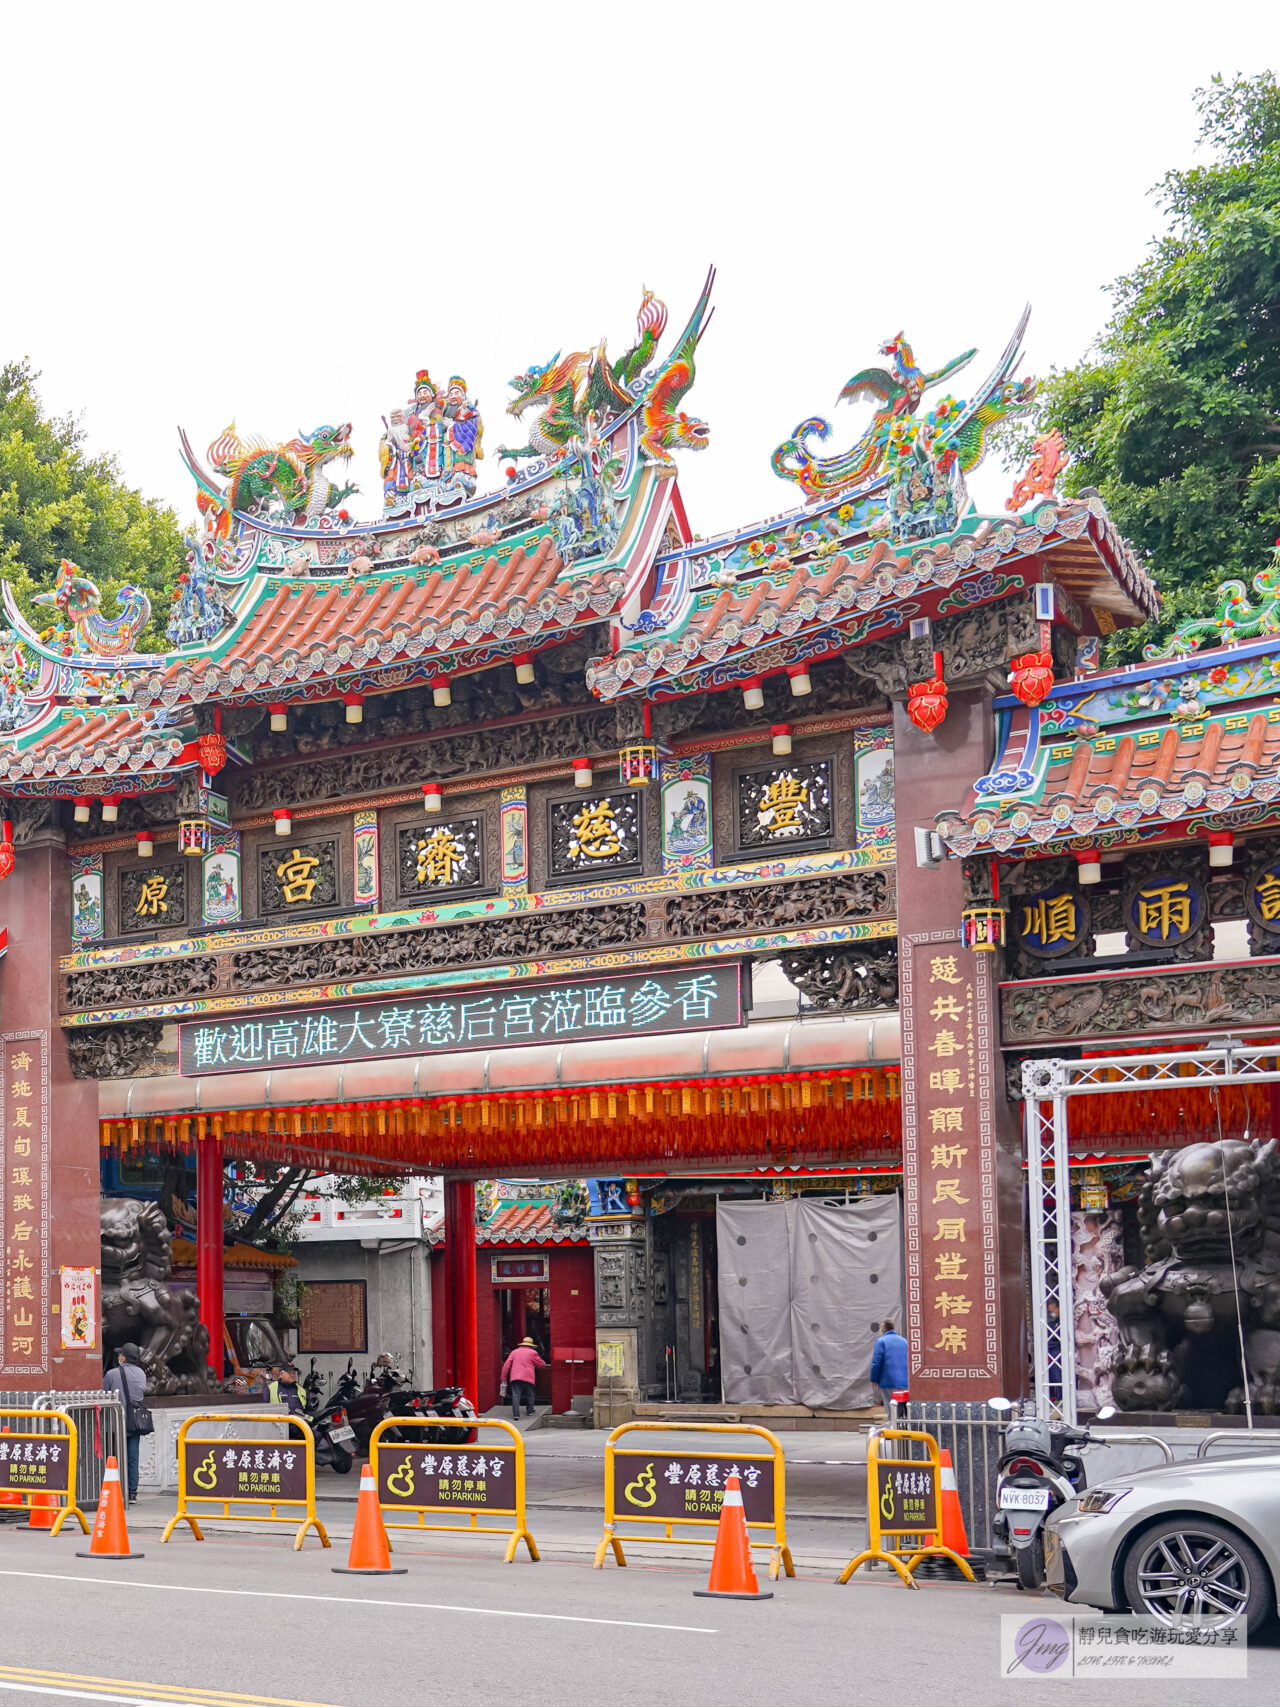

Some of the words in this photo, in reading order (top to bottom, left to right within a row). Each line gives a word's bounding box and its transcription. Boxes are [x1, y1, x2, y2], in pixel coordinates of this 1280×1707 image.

[759, 777, 808, 831] 豐
[569, 800, 620, 858] 慈
[415, 831, 464, 883] 濟
[276, 848, 319, 904] 宮
[135, 876, 168, 916] 原
[1021, 892, 1076, 945] 順
[1137, 881, 1192, 940] 雨
[193, 973, 719, 1069] 歡迎高雄大寮慈后宮蒞臨參香
[9, 1463, 47, 1474] 請勿停車
[222, 1448, 297, 1471] 豐原慈濟宮
[420, 1453, 505, 1478] 豐原慈濟宮
[9, 1474, 19, 1483] NO
[19, 1474, 47, 1484] PARKING
[238, 1471, 280, 1483] 請勿停車
[238, 1483, 249, 1492] NO
[250, 1483, 280, 1493] PARKING
[438, 1478, 487, 1491] 請勿停車
[895, 1471, 931, 1495] 豐原慈濟宮
[438, 1491, 451, 1500] NO
[452, 1491, 487, 1502] PARKING
[685, 1488, 725, 1502] 請勿停
[903, 1498, 925, 1511] 請勿停車
[685, 1502, 698, 1512] NO
[700, 1503, 722, 1513] PARK
[909, 1512, 926, 1522] PARKING
